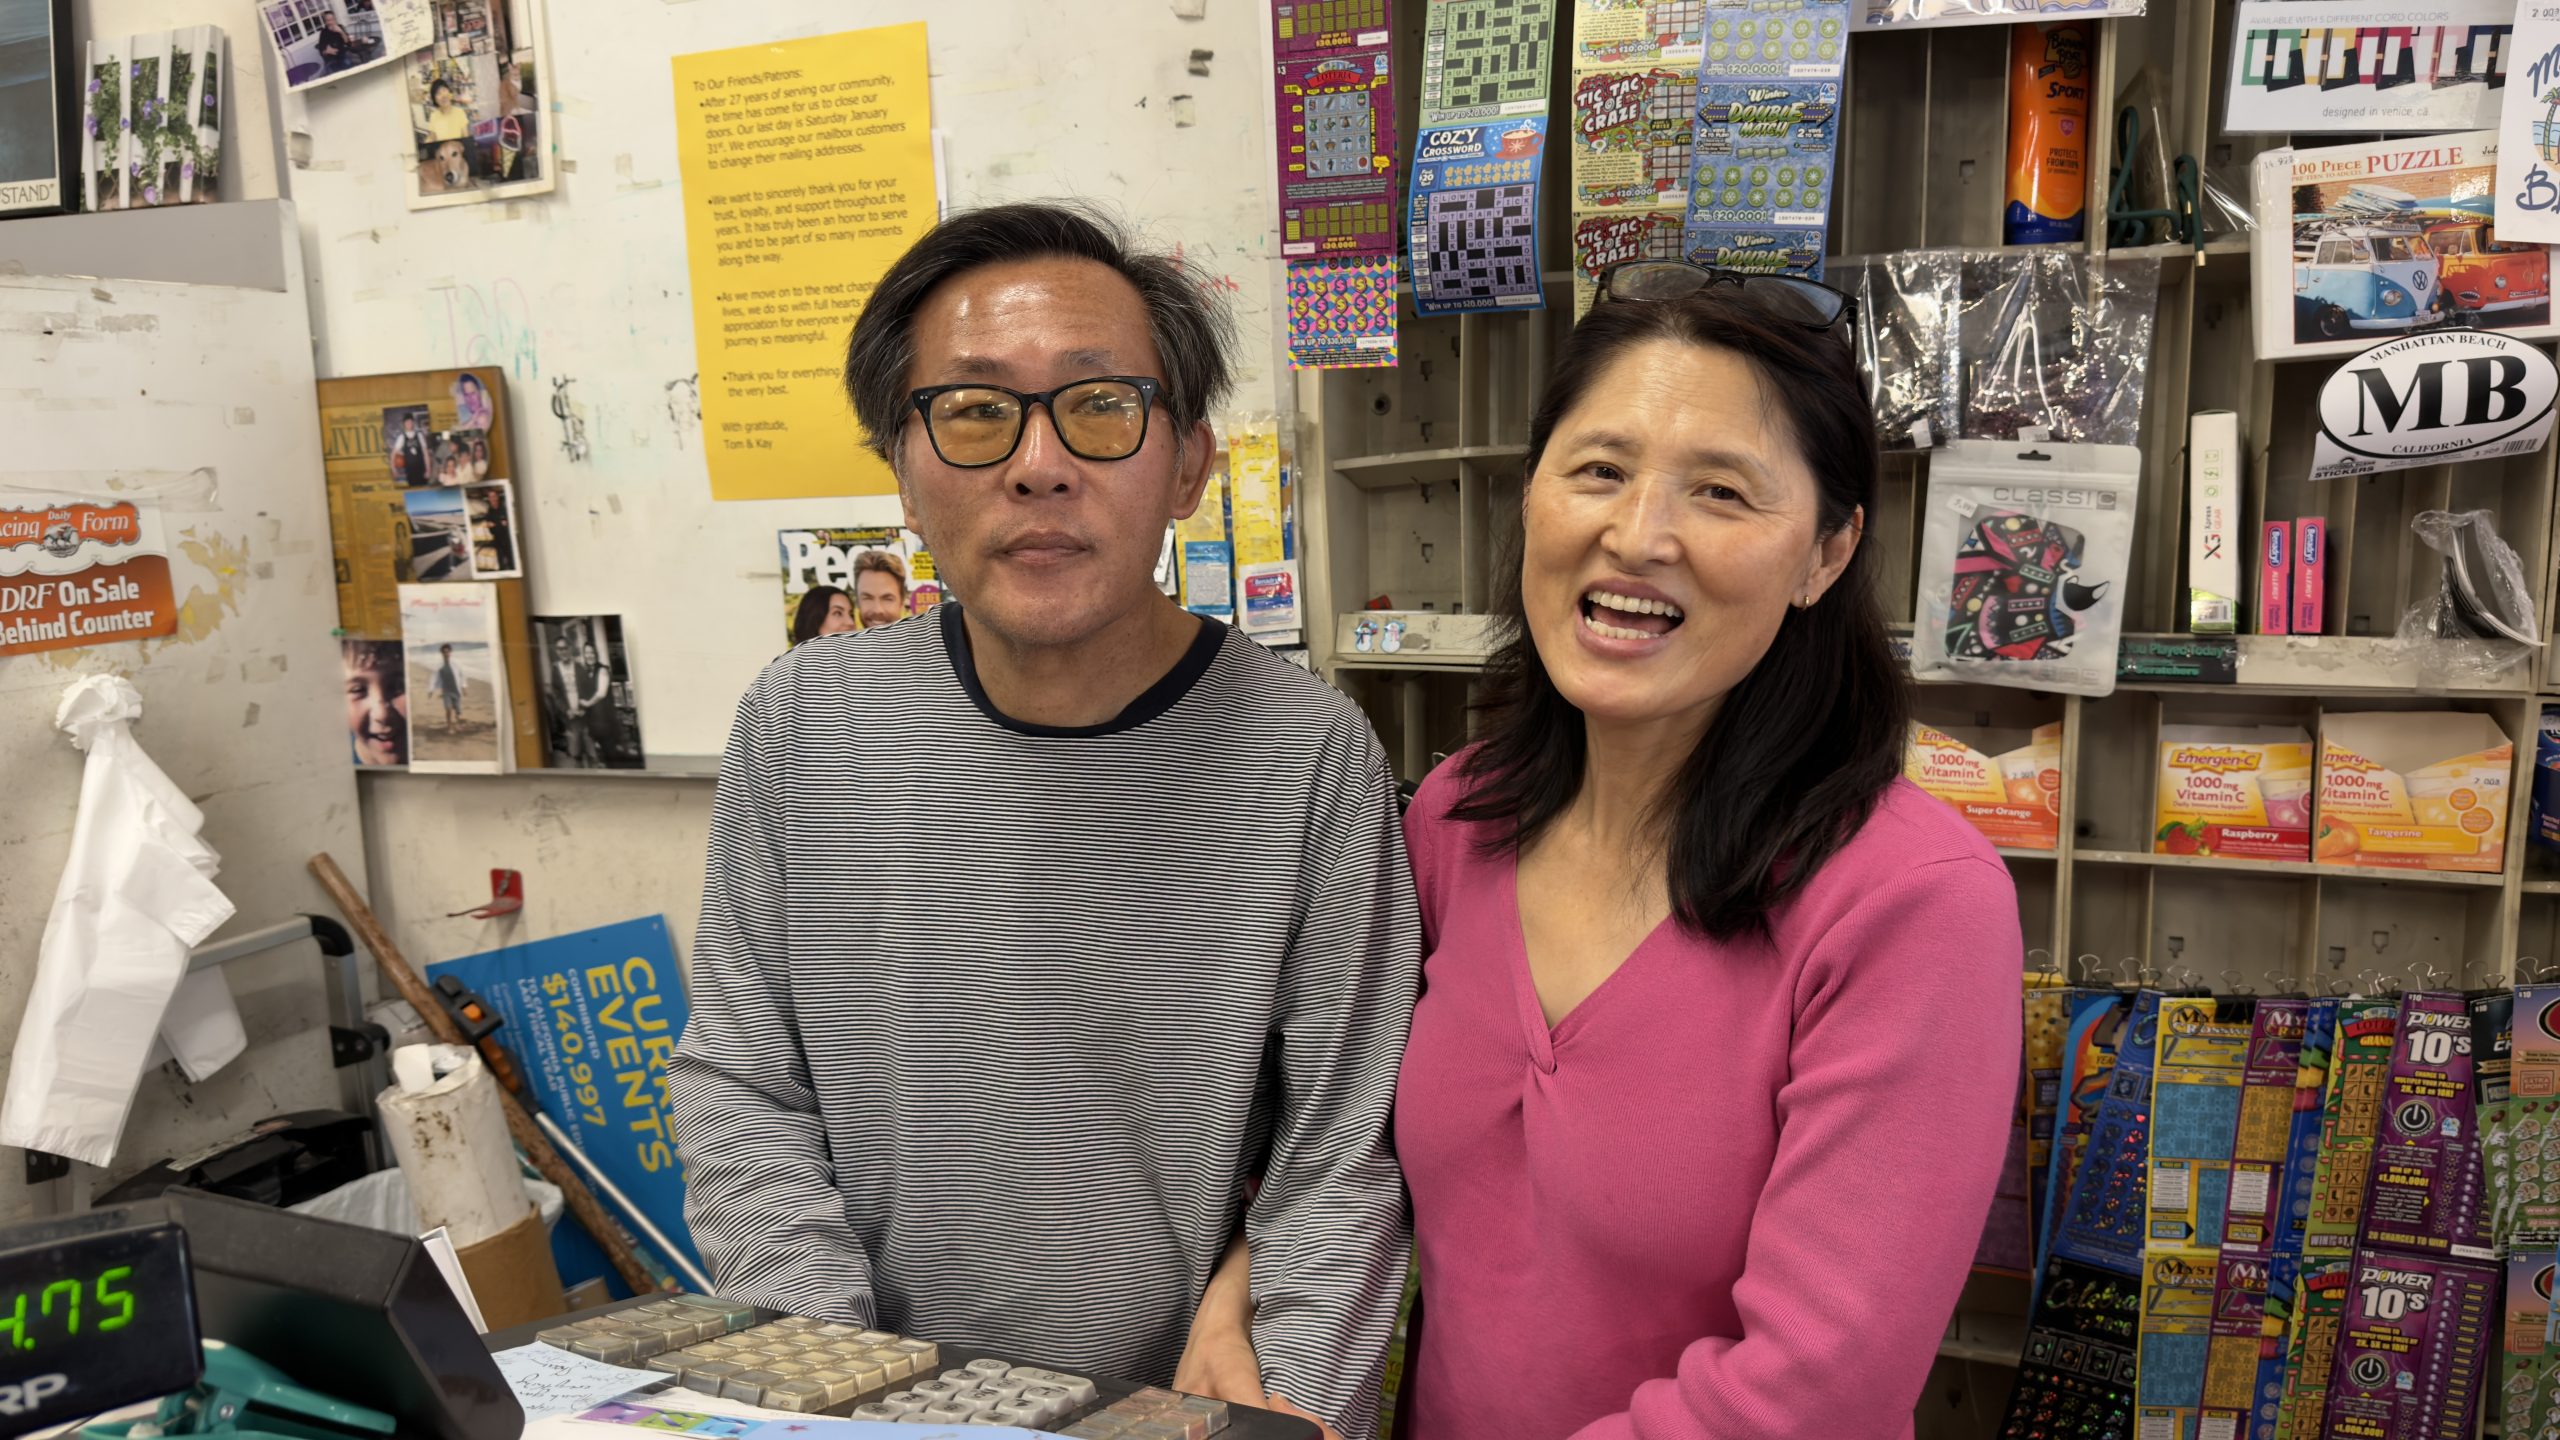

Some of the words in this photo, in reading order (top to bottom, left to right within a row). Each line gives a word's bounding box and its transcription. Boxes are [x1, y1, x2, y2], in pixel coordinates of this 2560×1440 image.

[2296, 15, 2317, 24] WITH
[2327, 14, 2373, 24] DIFFERENT
[2375, 13, 2406, 22] CORD
[2408, 12, 2449, 22] COLORS
[1577, 90, 1602, 107] TIC
[1610, 78, 1640, 96] TAC
[1748, 89, 1789, 102] Winter
[1593, 96, 1622, 114] TOE
[1728, 102, 1807, 124] DOUBLE
[2322, 106, 2365, 120] designed
[2369, 106, 2378, 116] in
[1584, 104, 1637, 132] CRAZE
[1430, 128, 1479, 146] COZY
[1740, 122, 1790, 138] MATCH
[1422, 143, 1482, 158] CROSSWORD
[2292, 164, 2316, 175] 100
[2322, 160, 2362, 172] PIECE
[2366, 147, 2464, 174] PUZZLE
[1578, 230, 1602, 246] TIC
[1609, 220, 1636, 236] TAC
[1734, 235, 1775, 248] Winter
[1593, 236, 1622, 252] TOE
[1586, 244, 1636, 268] CRAZE
[1716, 247, 1790, 266] DOUBLE
[2370, 334, 2456, 363] MANHATTAN
[2459, 334, 2507, 351] BEACH
[2348, 355, 2527, 438] MB
[2392, 438, 2474, 454] CALIFORNIA
[2314, 466, 2374, 479] STICKERS
[48, 511, 72, 520] Daily
[82, 512, 129, 532] Form
[0, 583, 56, 613] DRF
[58, 580, 91, 607] On
[92, 575, 140, 604] Sale
[70, 610, 154, 637] Counter
[1965, 760, 1980, 769] mg
[2176, 752, 2256, 768] Emergen-C
[1922, 766, 1974, 779] Vitamin
[1976, 769, 1986, 779] C
[2223, 782, 2238, 792] mg
[2366, 781, 2382, 790] mg
[2176, 789, 2232, 802] Vitamin
[2235, 792, 2245, 802] C
[2380, 790, 2390, 801] C
[1966, 804, 1994, 816] Super
[1996, 806, 2032, 819] Orange
[2222, 828, 2280, 842] Raspberry
[2368, 827, 2423, 838] Tangerine
[567, 968, 600, 1060] CONTRIBUTED
[534, 996, 562, 1073] CALIFORNIA
[542, 972, 608, 1127] $140,997
[2408, 1030, 2472, 1064] 10'S
[585, 964, 672, 1173] EVENTS
[2360, 1268, 2432, 1290] POWER
[2362, 1286, 2425, 1320] 10'S
